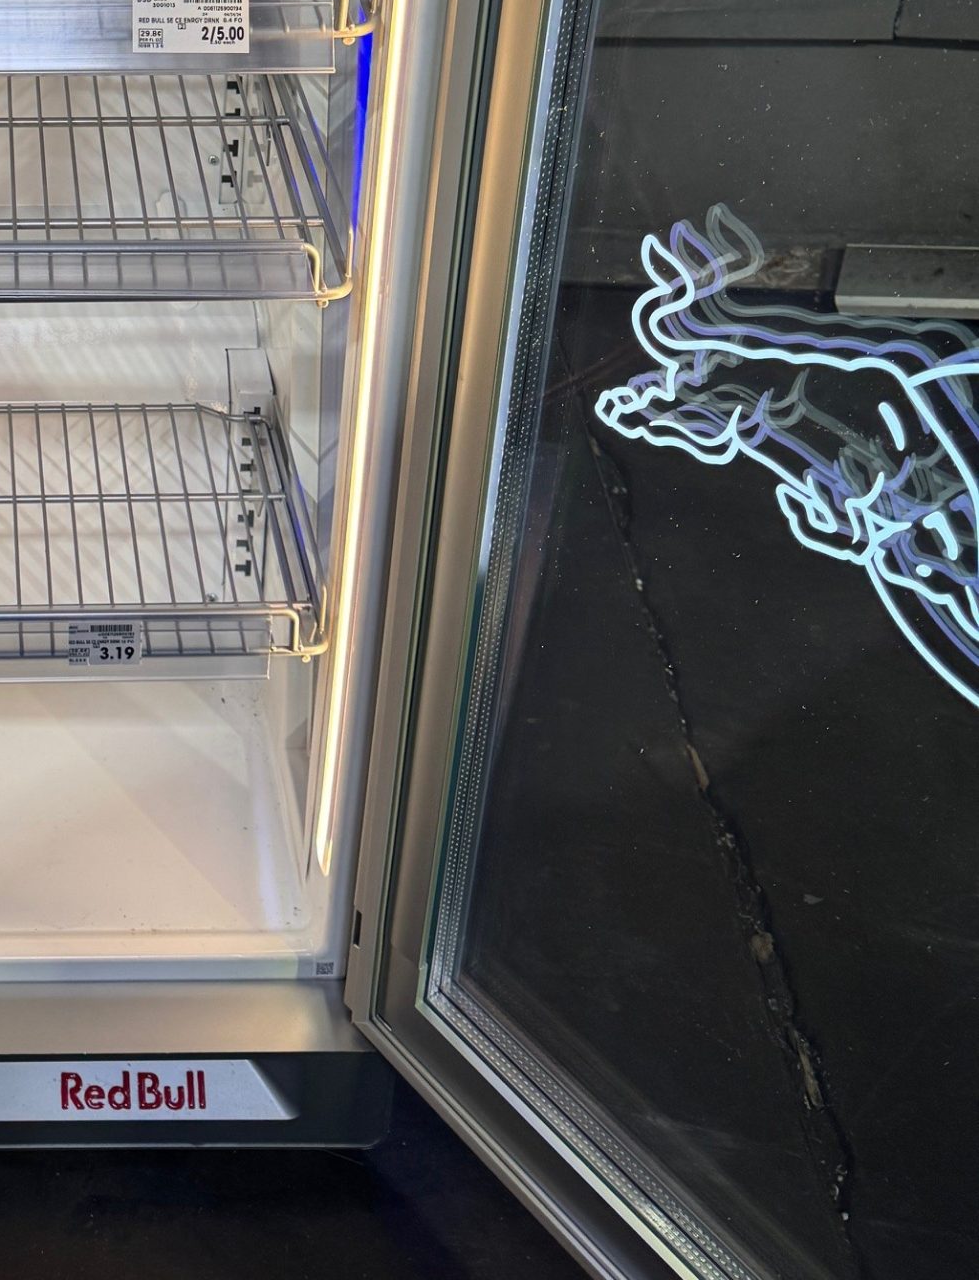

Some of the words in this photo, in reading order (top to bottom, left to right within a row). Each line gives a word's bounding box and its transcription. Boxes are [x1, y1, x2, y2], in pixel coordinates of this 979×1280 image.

[201, 26, 244, 42] 2/5.00
[100, 646, 135, 660] 3.19
[60, 1070, 131, 1110] Red
[137, 1070, 206, 1110] Bull
